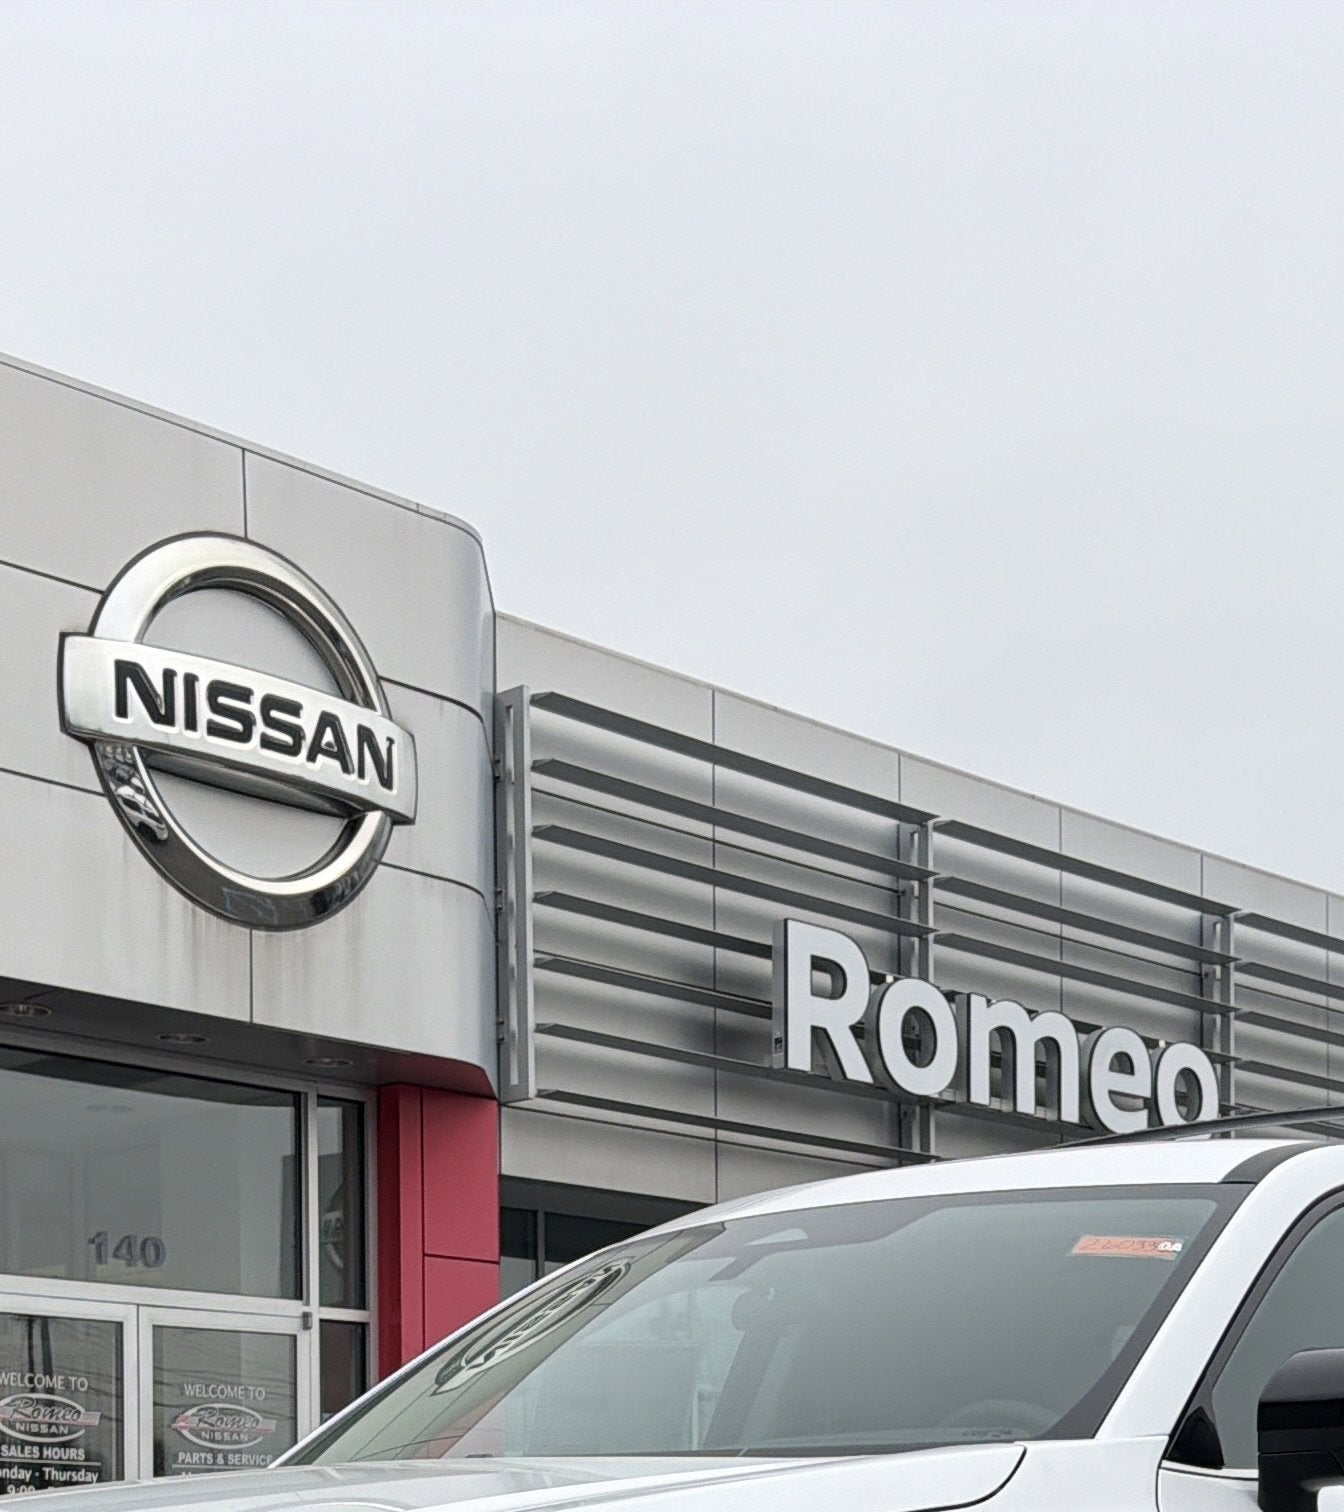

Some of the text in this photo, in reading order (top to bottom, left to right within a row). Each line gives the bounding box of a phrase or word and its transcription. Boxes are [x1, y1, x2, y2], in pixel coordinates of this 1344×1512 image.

[113, 658, 396, 792] NISSAN
[773, 917, 1219, 1139] Romeo
[88, 1230, 167, 1268] 140
[67, 1376, 88, 1391] TO
[184, 1384, 266, 1400] WELCOME TO
[9, 1397, 82, 1421] Romeo
[16, 1422, 69, 1434] NISSAN
[201, 1431, 248, 1441] NISSAN
[0, 1444, 85, 1460] SALES HOURS
[178, 1452, 274, 1466] PARTS & SERVICE
[42, 1466, 99, 1484] Thursday
